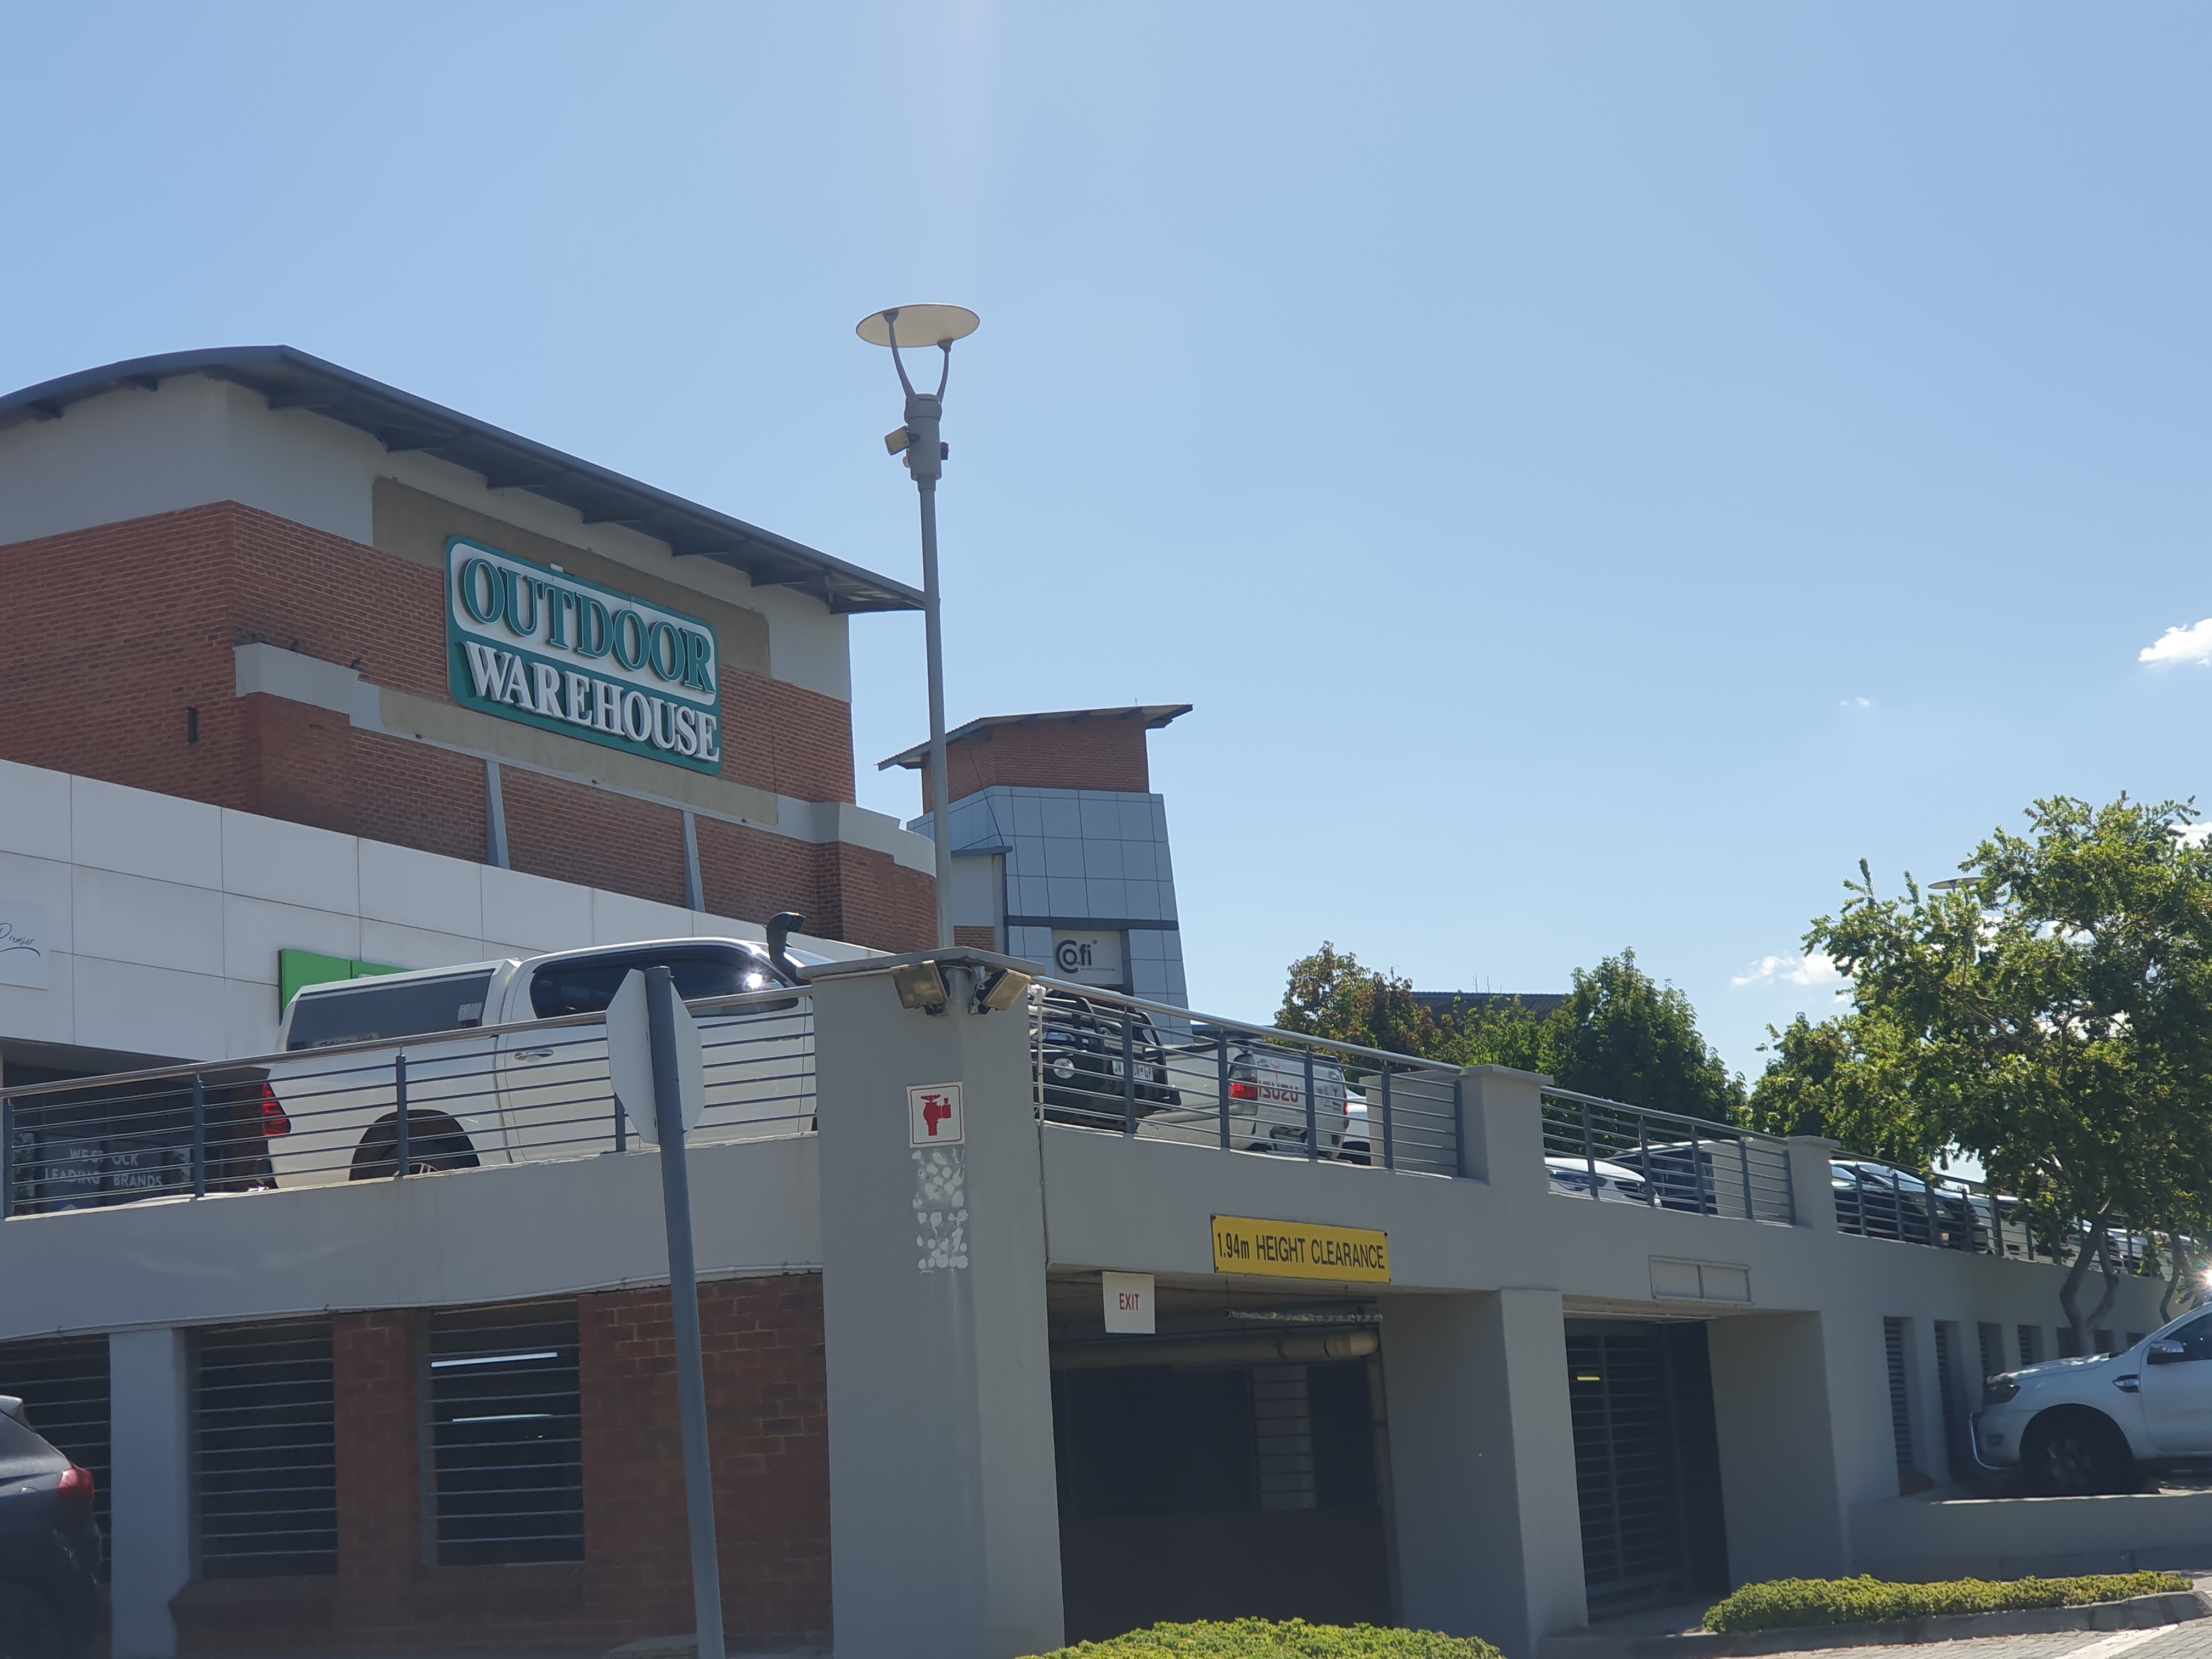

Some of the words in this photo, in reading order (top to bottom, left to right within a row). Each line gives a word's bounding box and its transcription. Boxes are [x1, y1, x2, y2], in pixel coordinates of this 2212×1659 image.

[463, 557, 716, 693] OUTDOOR
[465, 641, 719, 763] WAREHOUSE
[1259, 1080, 1299, 1103] ISUZU
[44, 1167, 101, 1185] LEADING
[113, 1173, 163, 1187] BRANDS
[1217, 1232, 1250, 1260] 1.94m
[1255, 1234, 1306, 1263] HEIGHT
[1311, 1239, 1386, 1269] CLEARANCE
[1119, 1293, 1140, 1311] EXIT
